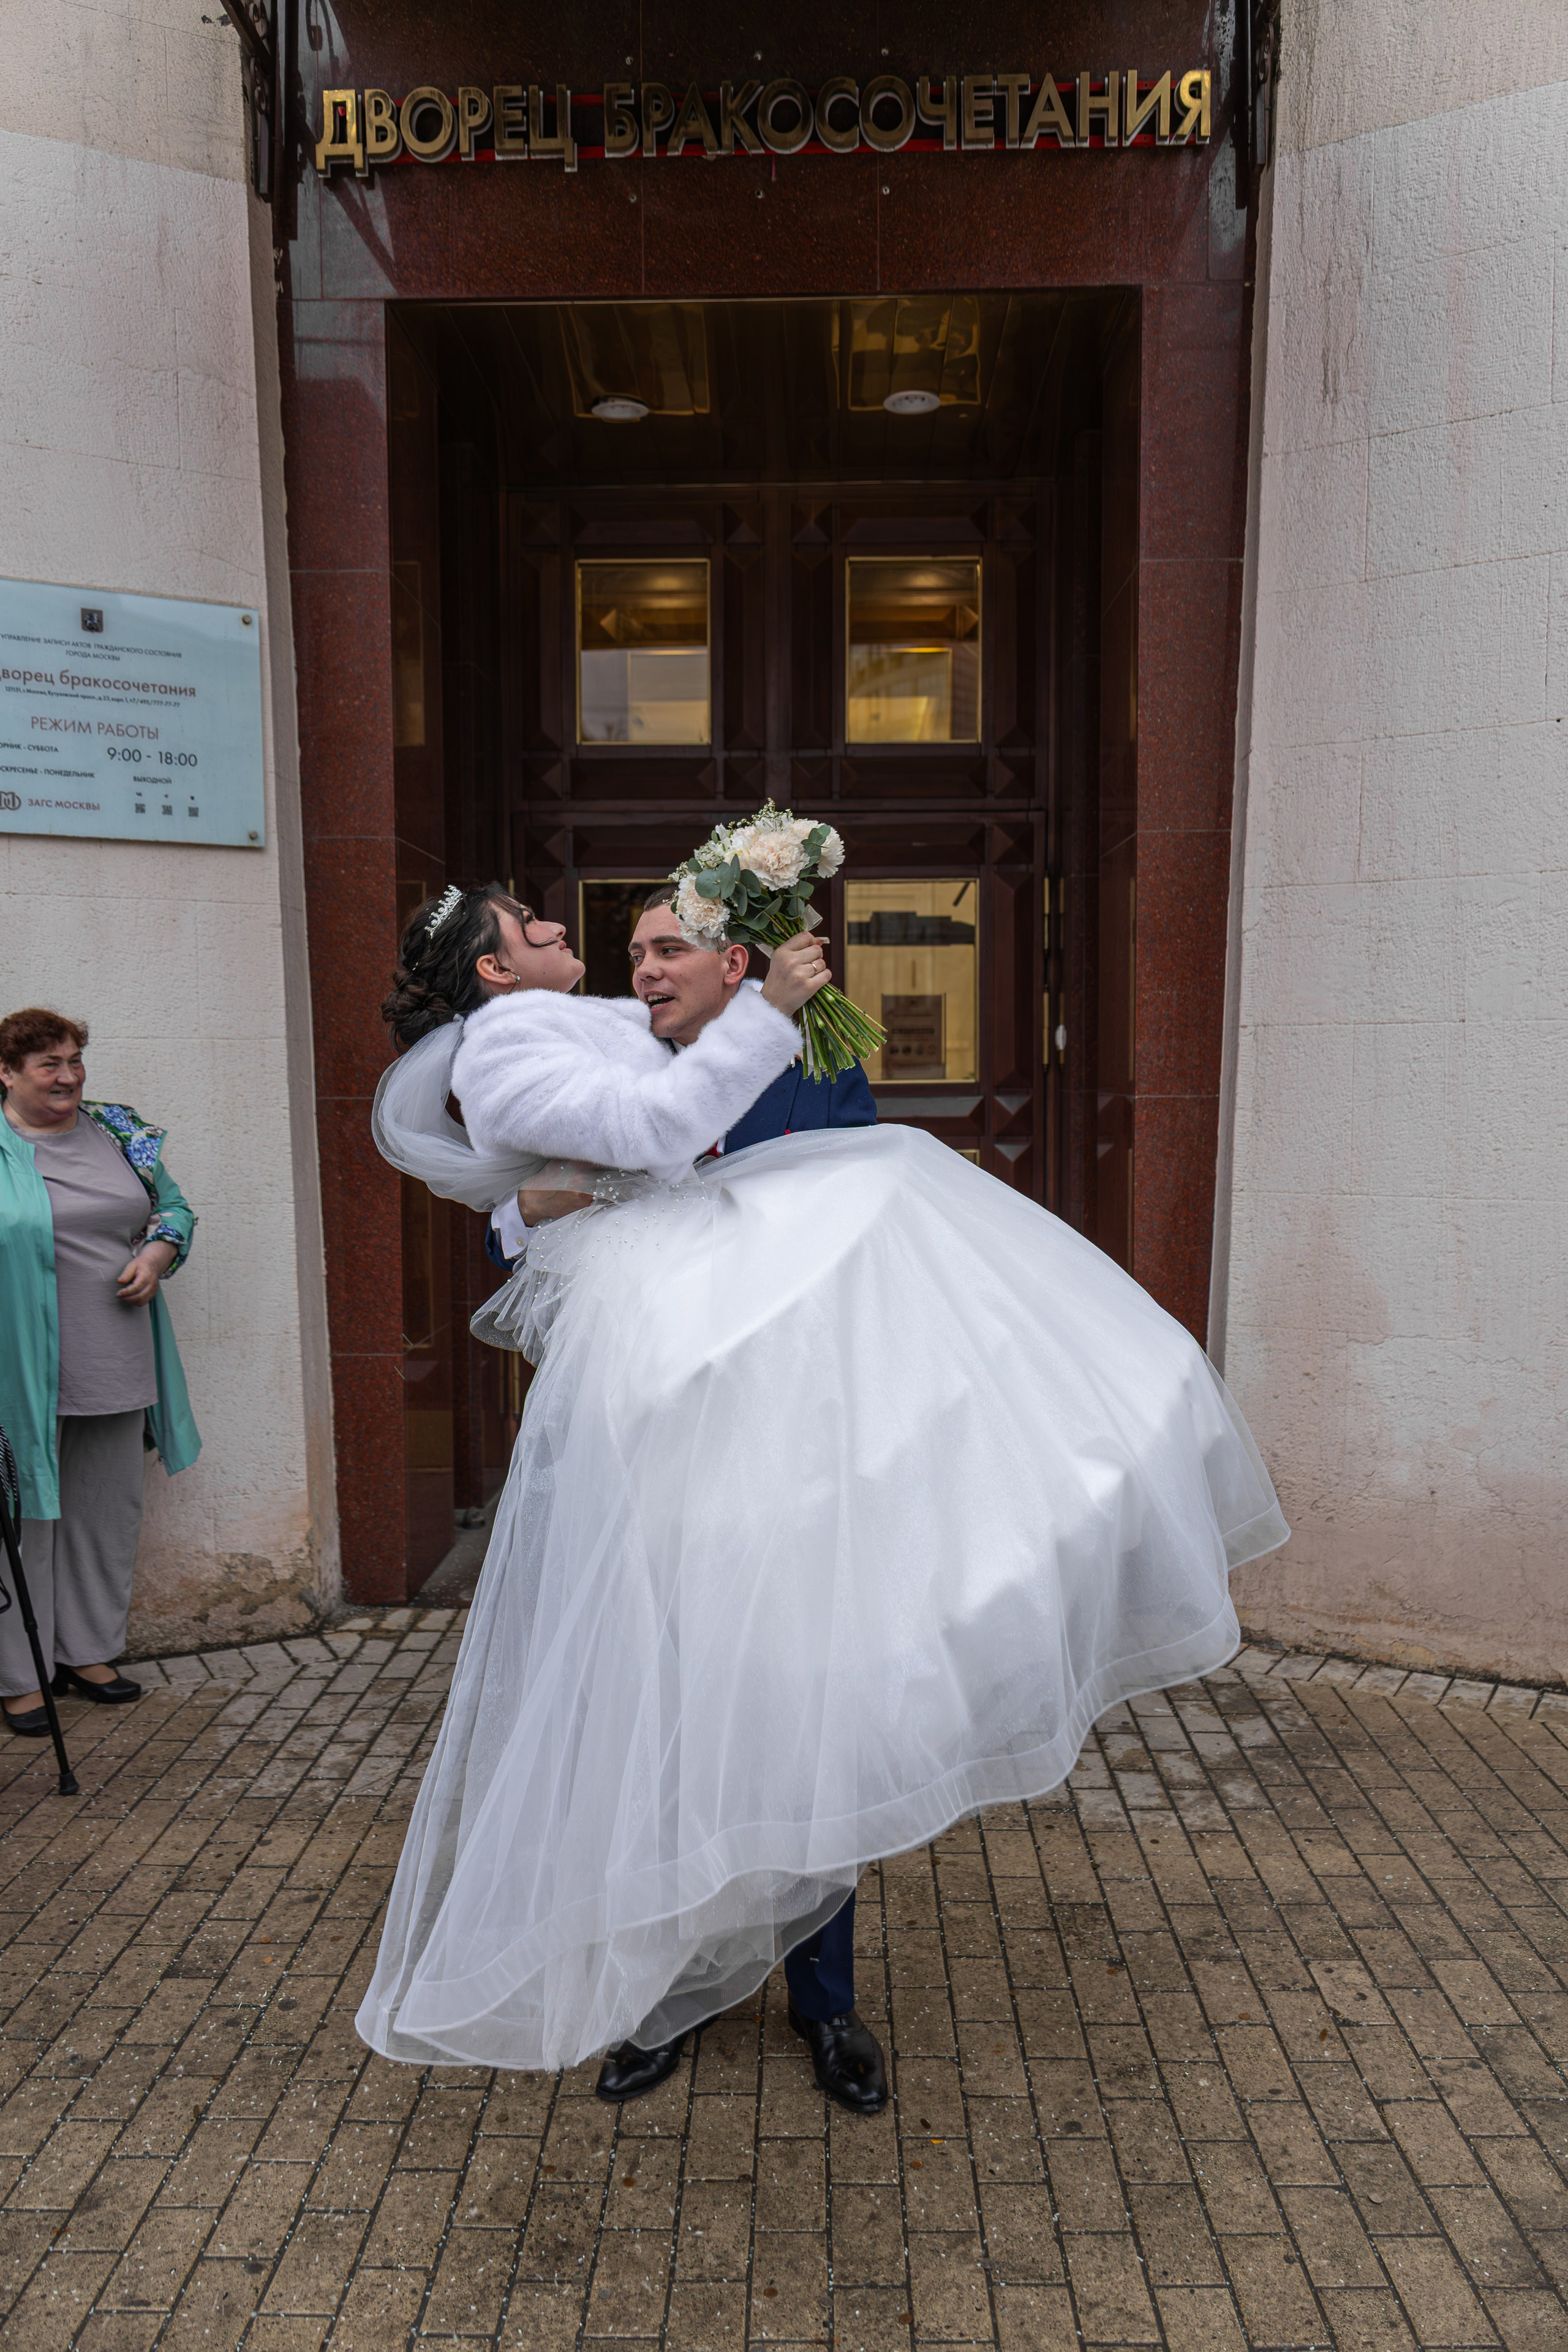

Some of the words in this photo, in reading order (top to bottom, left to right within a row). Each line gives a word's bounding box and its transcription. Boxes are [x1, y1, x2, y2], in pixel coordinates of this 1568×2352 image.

[315, 84, 577, 173] ДВОРЕЦ
[603, 69, 1211, 157] БРАКОСОЧЕТАНИЯ
[1, 633, 41, 644] УПРАВЛЕНИЕ
[43, 638, 70, 646] ЗАПИСИ
[94, 643, 143, 654] ГРАЖДАНСКОГО
[144, 649, 182, 658] СОСТОЯНИЯ
[66, 650, 91, 658] ГОРОДА
[0, 668, 55, 686] ворец
[59, 669, 196, 697] бракосочетания
[31, 716, 92, 734] РЕЖИМ
[97, 722, 159, 740] РАБОТЫ
[27, 744, 59, 753] СУББОТА
[107, 747, 141, 763] 9:00
[158, 751, 197, 767] 18:00
[44, 769, 95, 778] ПОНЕДЕЛЬНИК
[133, 775, 172, 785] ВЫХОДНОЙ
[28, 798, 53, 807] ЗАГС
[55, 800, 100, 811] МОСКВЫ
